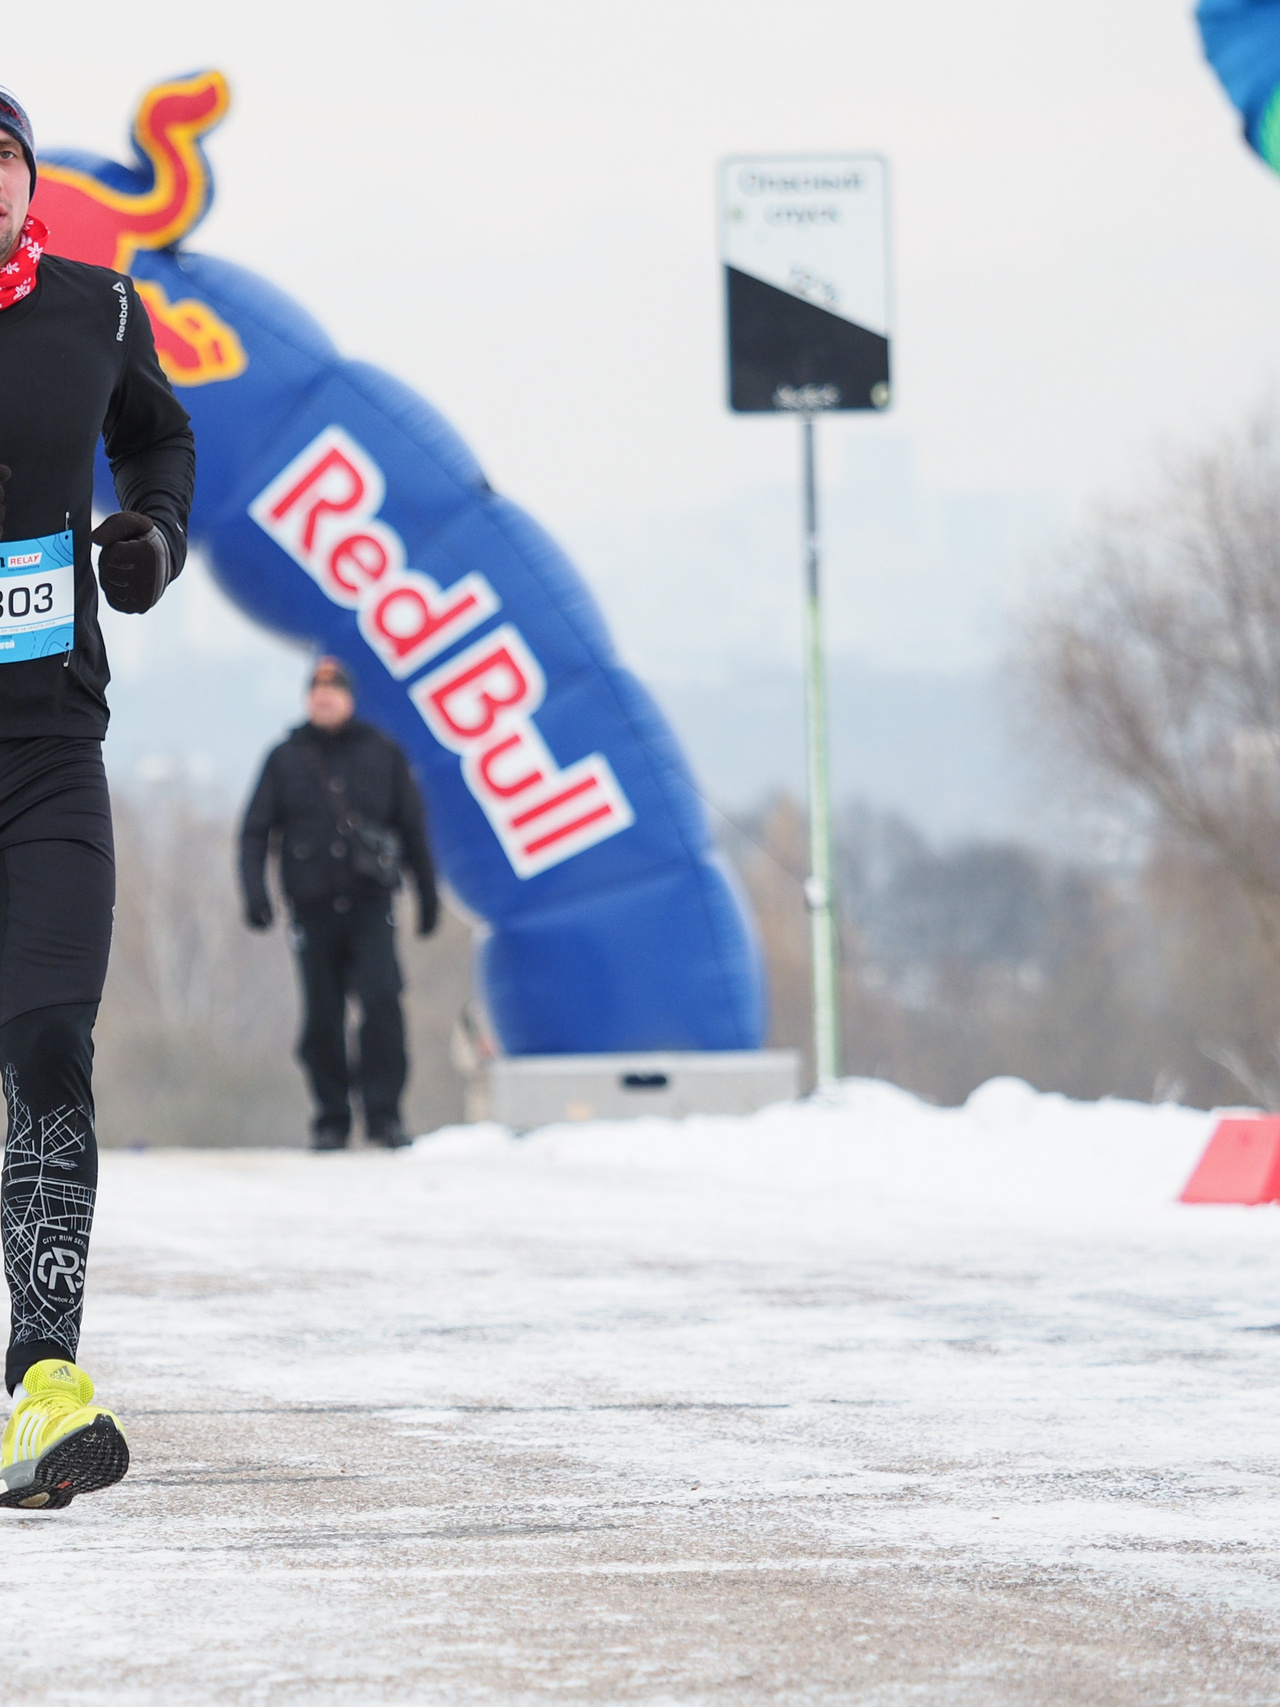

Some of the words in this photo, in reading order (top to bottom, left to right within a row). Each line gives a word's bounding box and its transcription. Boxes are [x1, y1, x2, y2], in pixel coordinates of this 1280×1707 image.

[115, 295, 128, 342] Reebok
[10, 554, 40, 566] RELAY
[261, 437, 488, 670] Red
[420, 637, 622, 865] Bull
[42, 1235, 57, 1245] CITY
[58, 1234, 73, 1242] RUN
